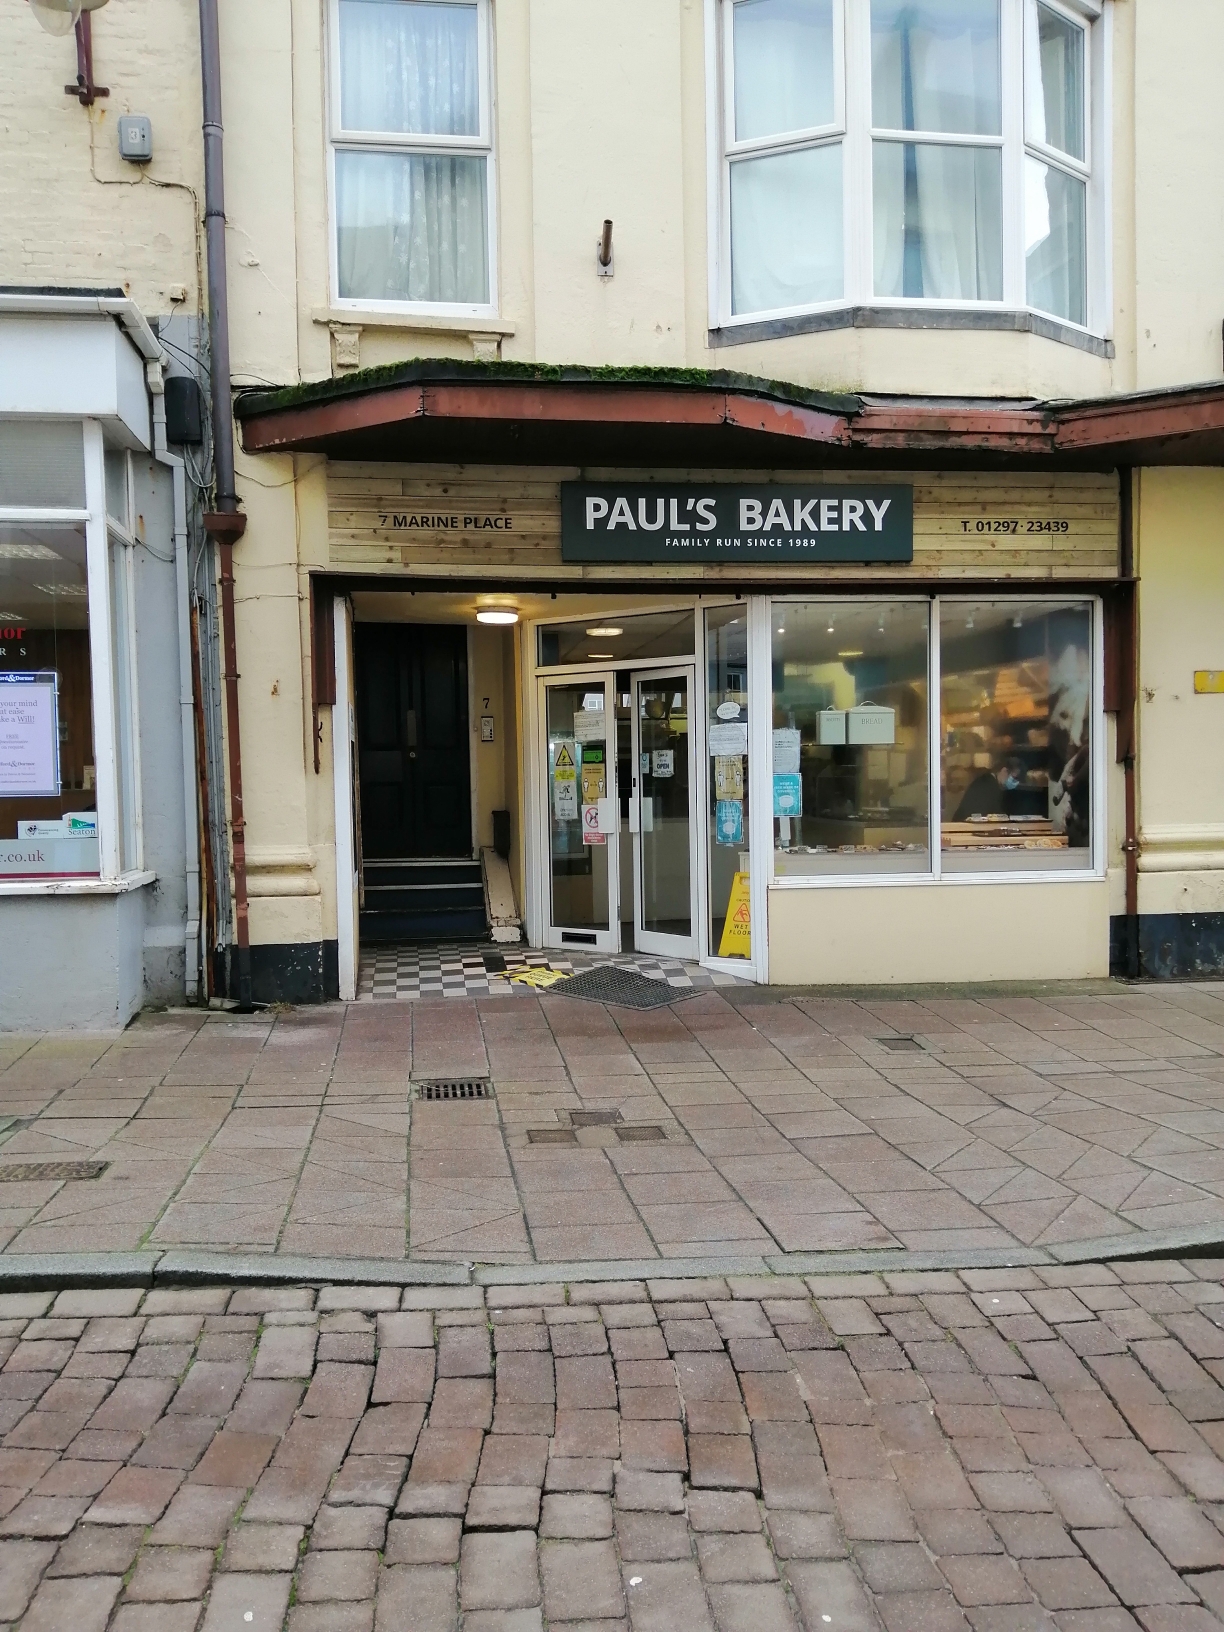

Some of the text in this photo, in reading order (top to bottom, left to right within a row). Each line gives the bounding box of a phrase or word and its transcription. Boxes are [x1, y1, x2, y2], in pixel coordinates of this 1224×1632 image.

[585, 497, 892, 531] PAUL'S BAKERY
[378, 514, 513, 529] 7 MARINE PLACE
[665, 538, 816, 547] FAMILY RUN SINCE 1989
[483, 698, 490, 709] 7
[68, 828, 96, 836] Seaton
